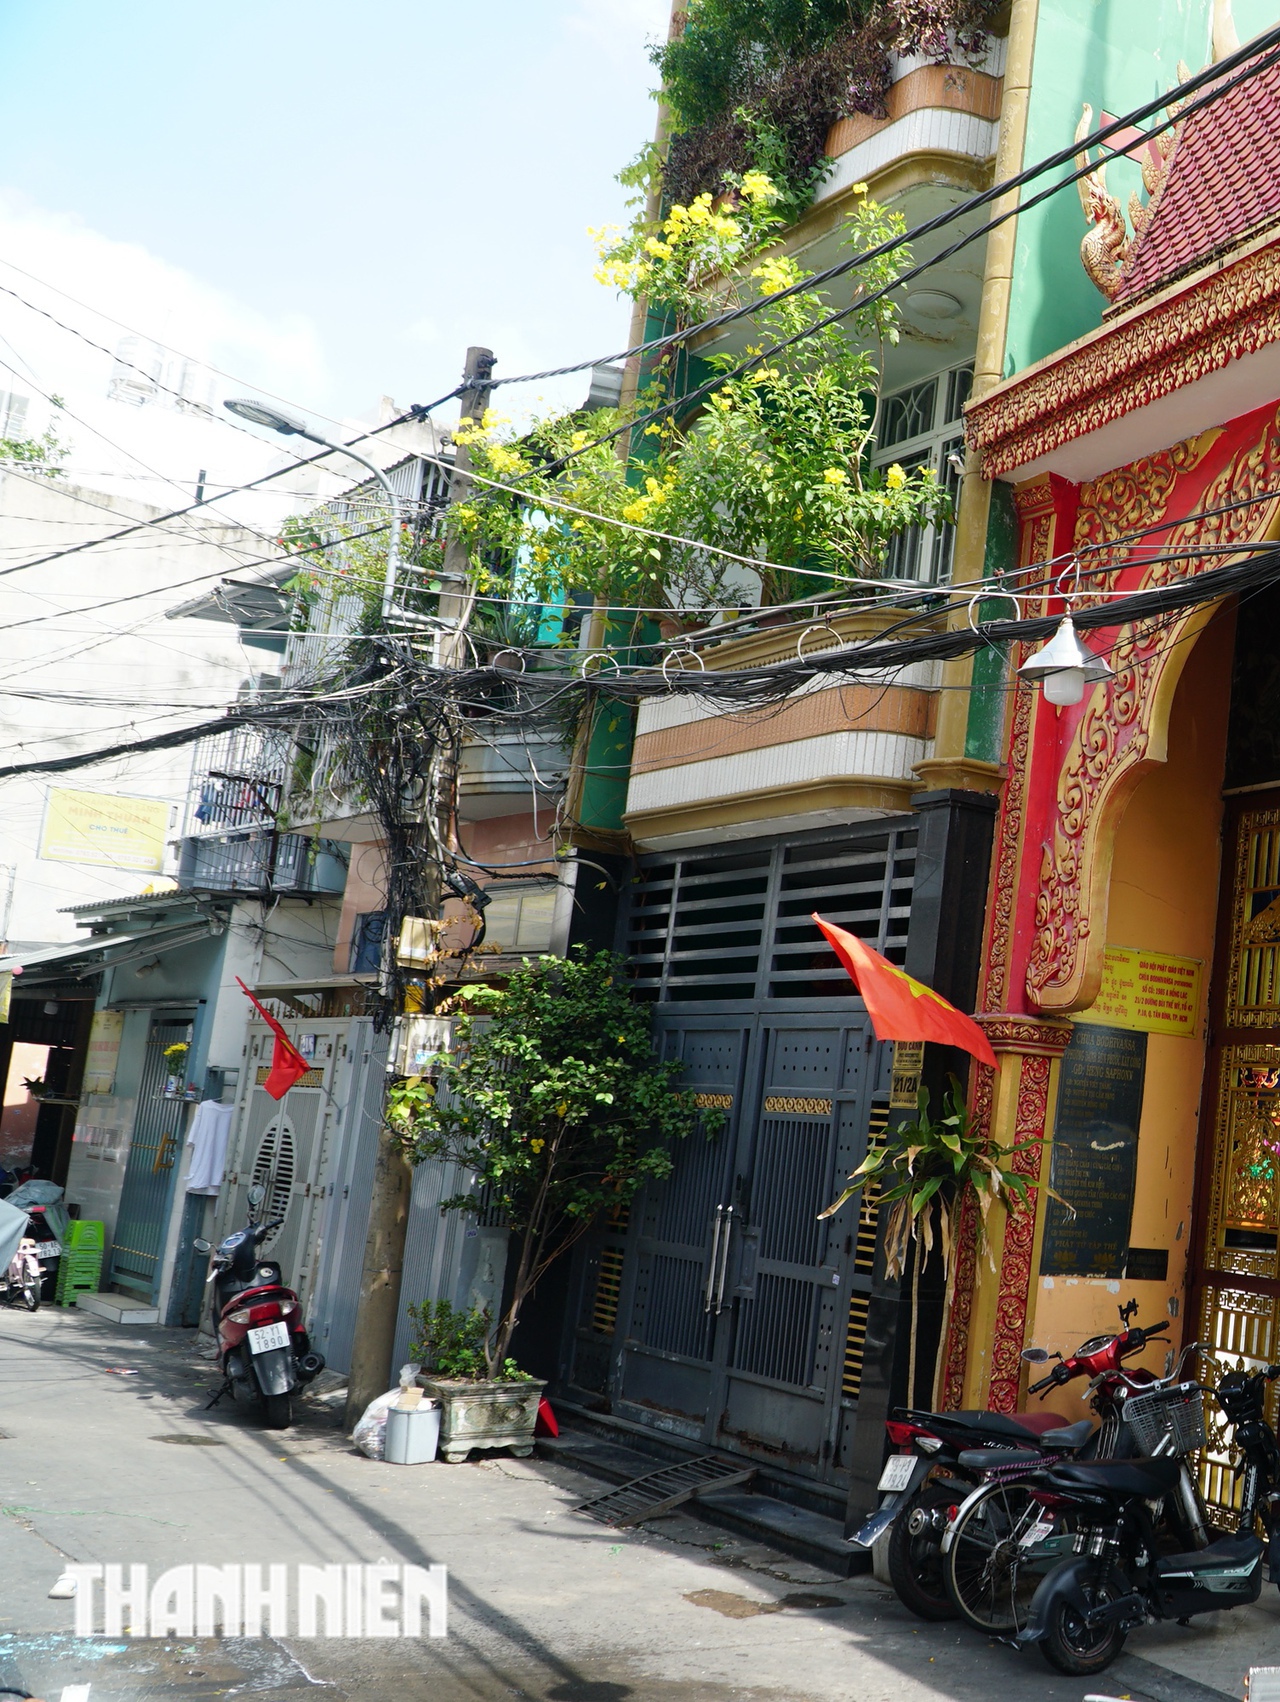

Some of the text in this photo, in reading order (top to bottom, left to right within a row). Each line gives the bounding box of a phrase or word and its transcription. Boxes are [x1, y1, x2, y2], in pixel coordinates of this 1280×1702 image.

[89, 824, 107, 832] CHO
[893, 1076, 917, 1093] 21/2A
[254, 1325, 280, 1341] 52-Y1
[256, 1335, 284, 1351] 1890
